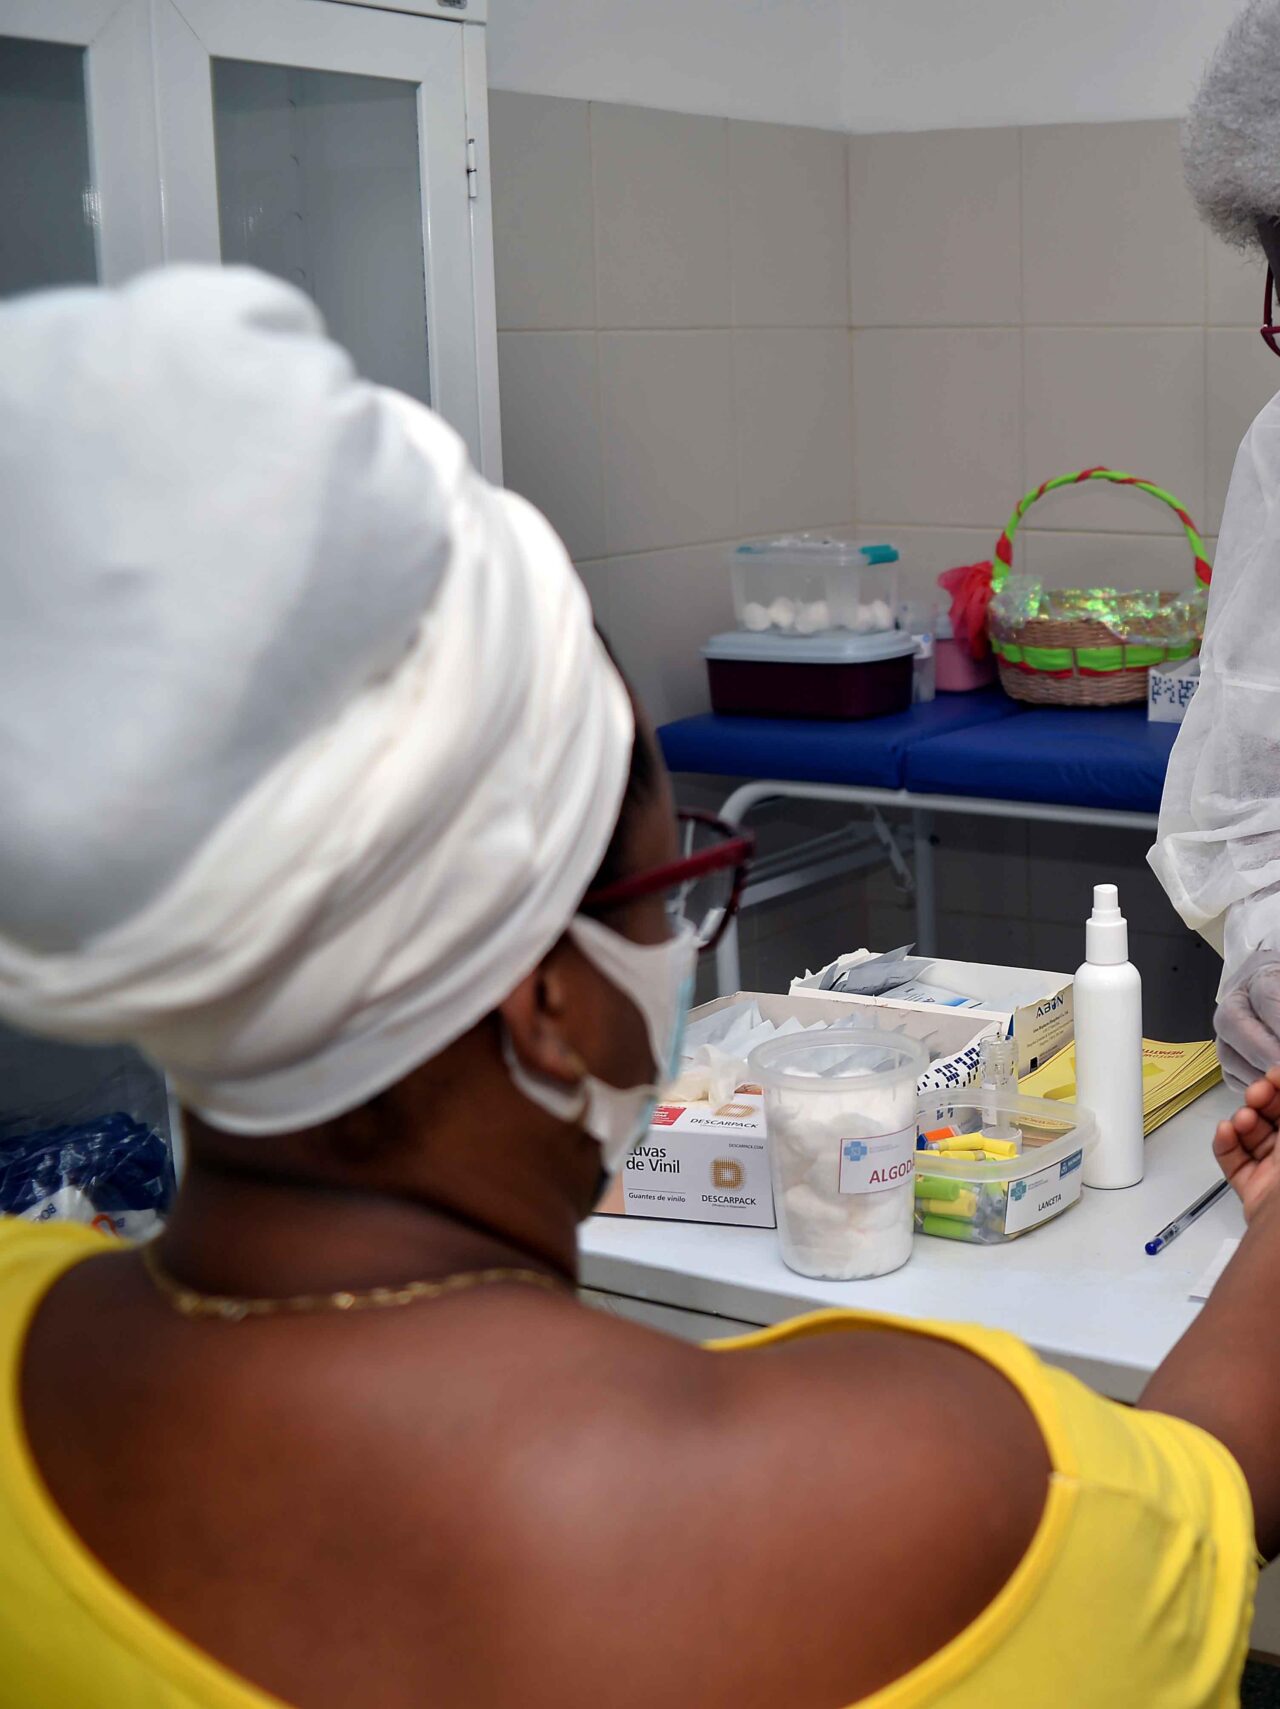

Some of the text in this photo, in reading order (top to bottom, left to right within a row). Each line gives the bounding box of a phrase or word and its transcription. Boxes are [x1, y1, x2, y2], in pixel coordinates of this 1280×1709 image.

[690, 1118, 759, 1129] DESCARPACK
[627, 1146, 667, 1158] uvas
[626, 1157, 680, 1174] de Vinil
[869, 1159, 913, 1184] ALGOD
[628, 1192, 686, 1203] Guantes de vinilo
[701, 1194, 757, 1206] DESCARPACK
[1038, 1193, 1062, 1212] LANCETA
